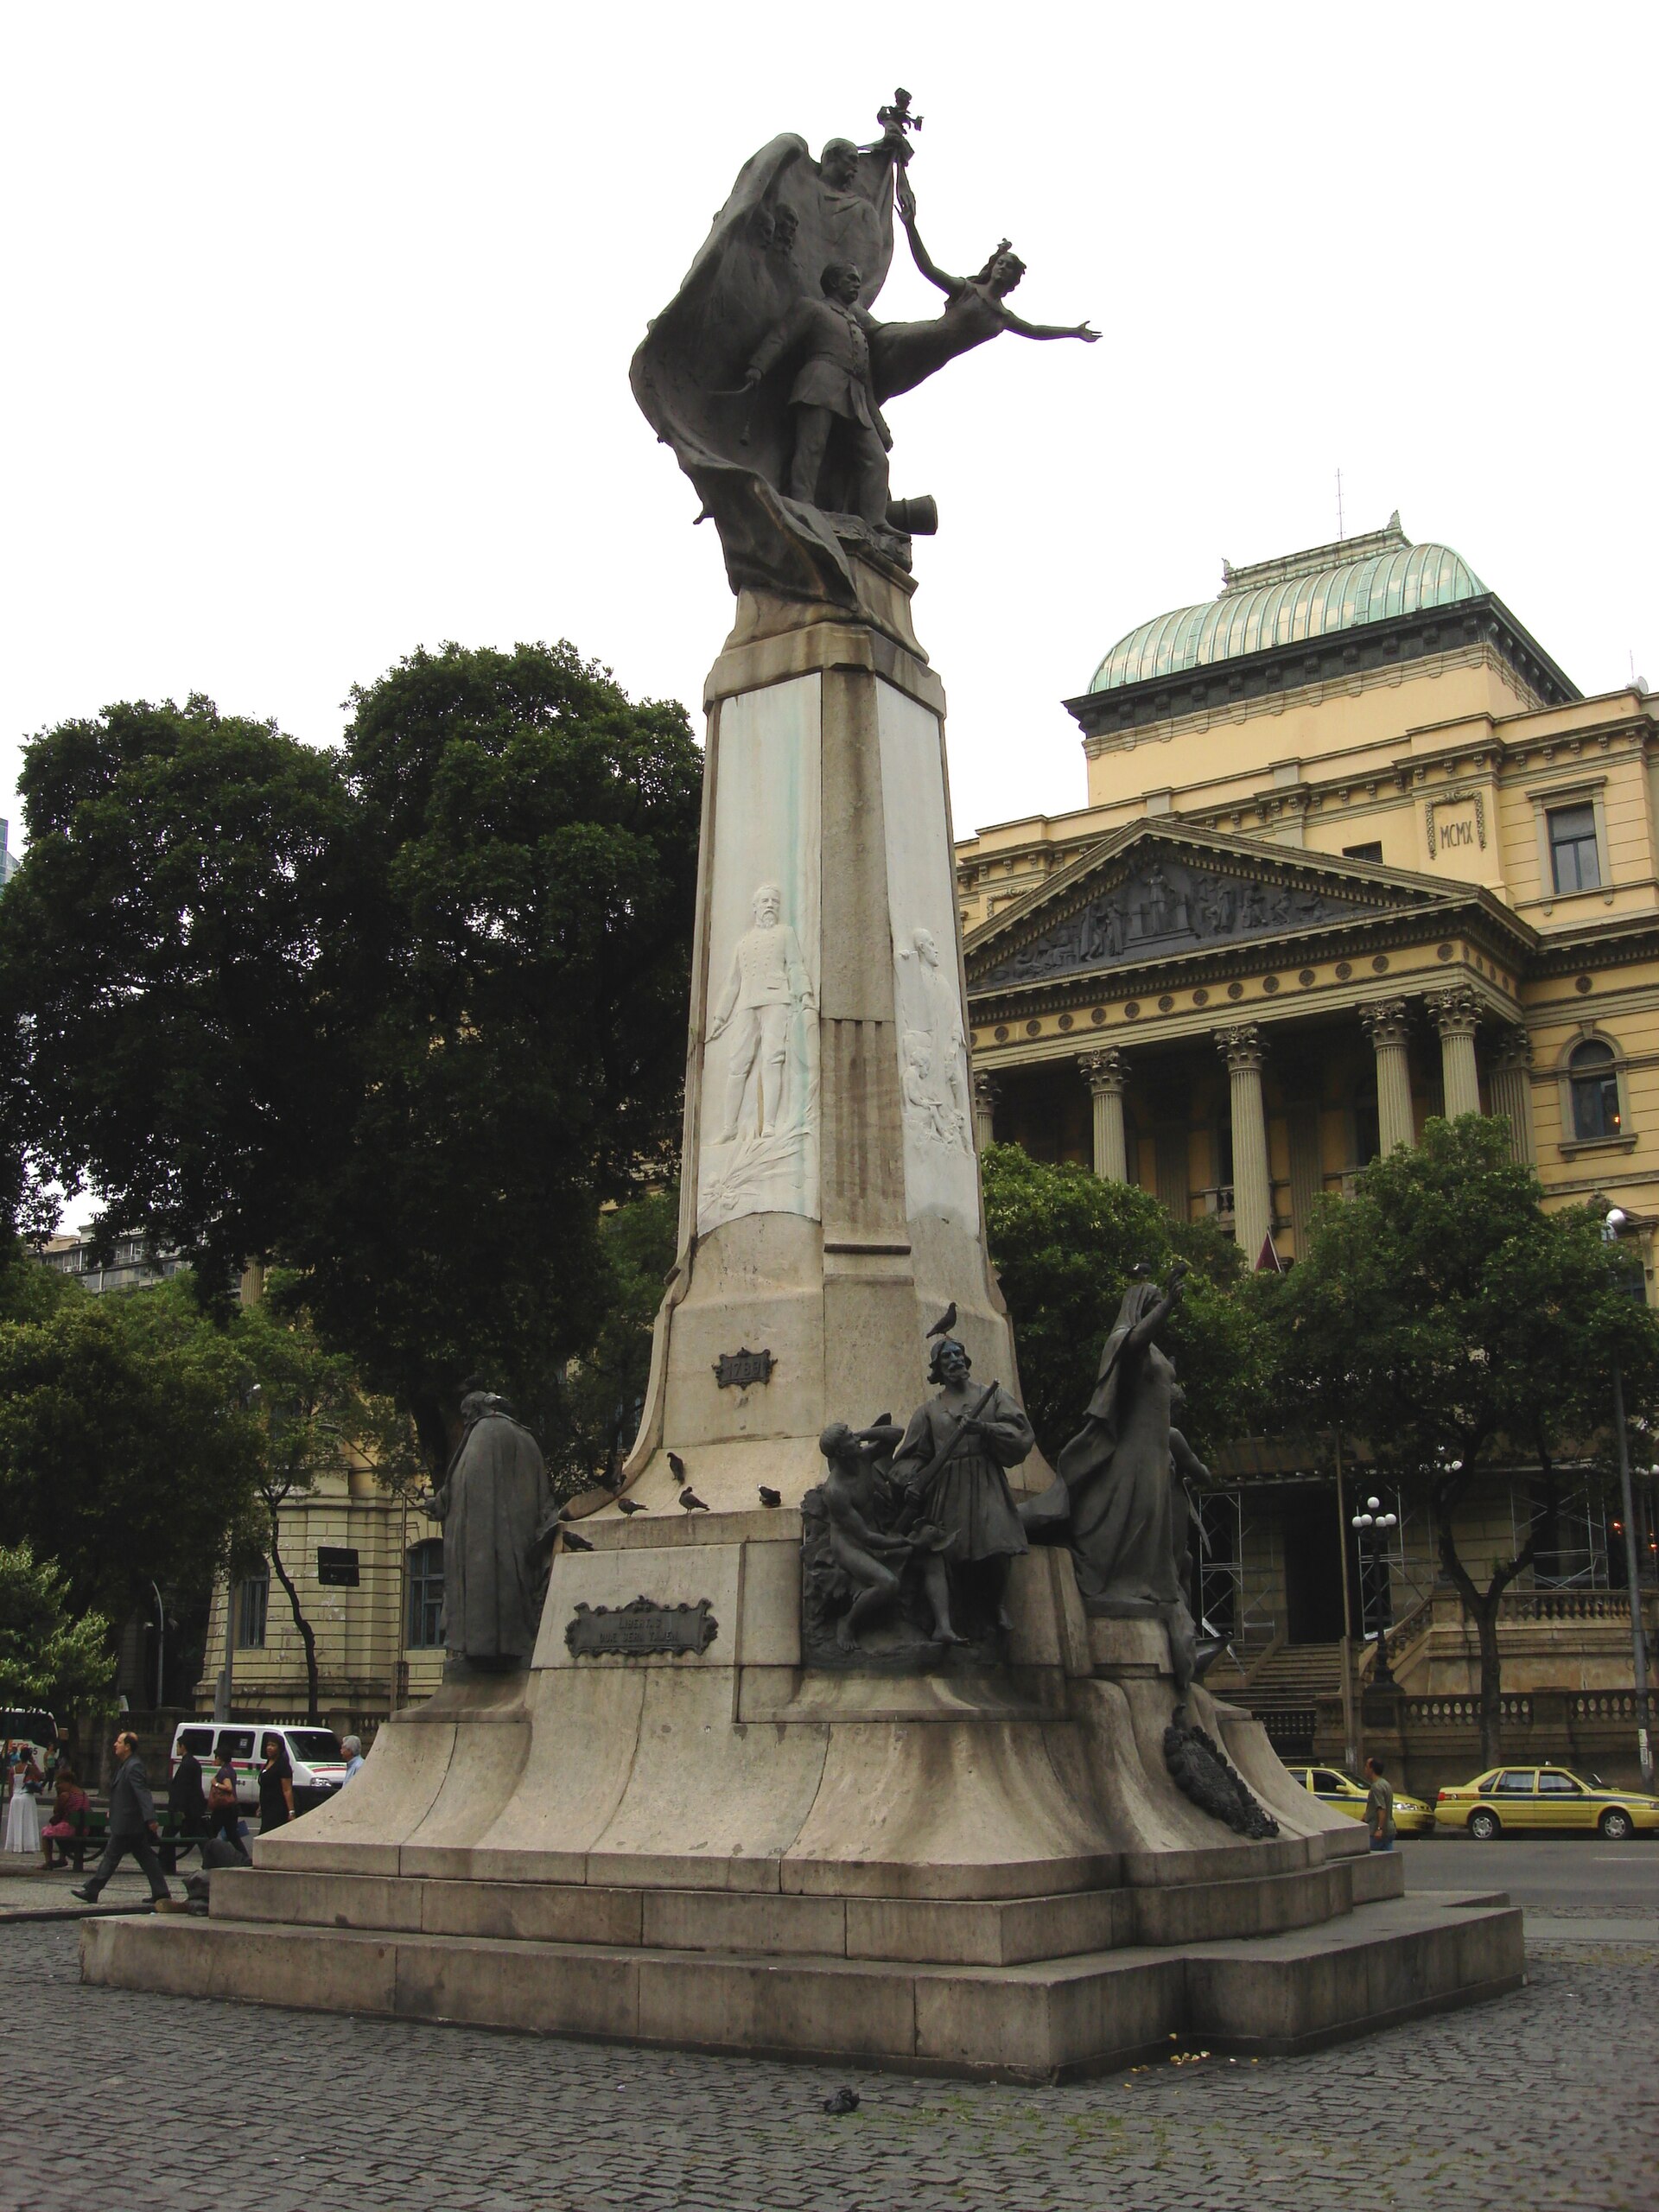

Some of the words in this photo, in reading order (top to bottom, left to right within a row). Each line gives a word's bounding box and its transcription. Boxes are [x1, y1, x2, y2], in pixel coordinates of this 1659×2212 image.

[1440, 821, 1473, 849] MCMX
[730, 1360, 760, 1376] 1789
[619, 1616, 662, 1629] LIBERTAS
